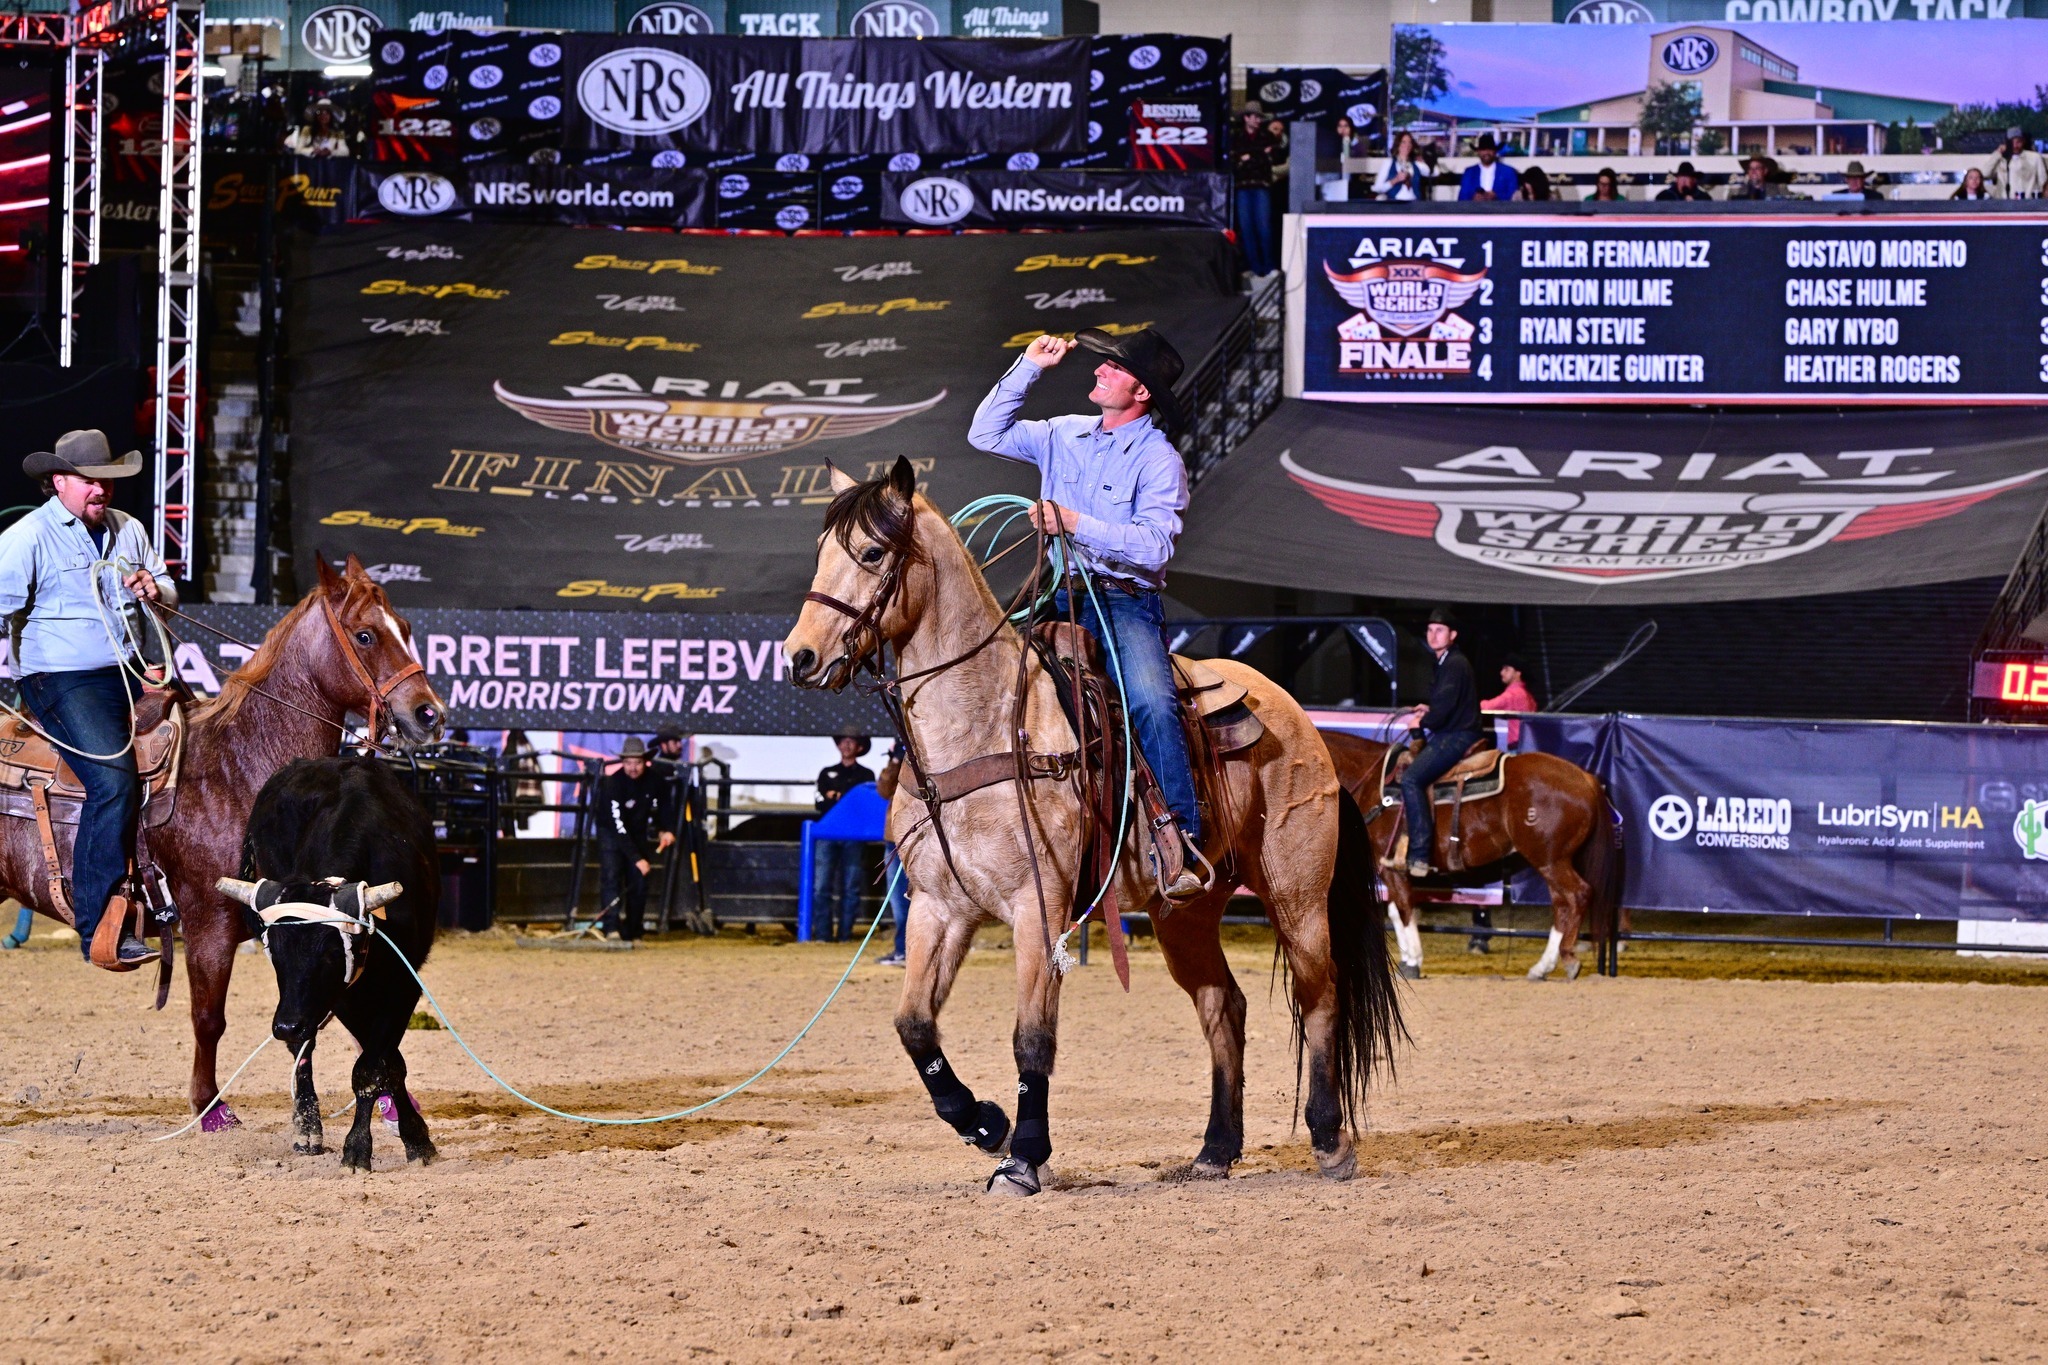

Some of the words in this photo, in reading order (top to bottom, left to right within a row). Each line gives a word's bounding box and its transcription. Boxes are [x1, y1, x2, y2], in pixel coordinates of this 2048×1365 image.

[409, 12, 436, 32] All
[739, 13, 821, 37] TACK
[963, 7, 990, 29] All
[991, 7, 1049, 29] Things
[314, 11, 372, 58] NRS
[1668, 38, 1709, 70] NRS
[601, 59, 687, 122] NRS
[731, 70, 789, 113] All
[795, 70, 917, 121] Things
[924, 70, 1073, 110] Western
[377, 118, 452, 137] 122
[1136, 126, 1208, 145] 122
[391, 177, 443, 210] NRS
[474, 182, 675, 208] NRSworld.com
[913, 184, 960, 218] NRS
[991, 188, 1185, 212] NRSworld.com
[100, 197, 161, 222] ester
[1354, 237, 1459, 257] ARIAT
[1481, 240, 1493, 268] 1
[1521, 240, 1589, 268] ELMER
[1592, 240, 1711, 268] FERNANDEZ
[1786, 239, 1877, 268] GUSTAVO
[1880, 239, 1967, 268] MORENO
[1393, 267, 1421, 278] XIX
[1369, 281, 1444, 297] WORLD
[1479, 278, 1494, 306] 2
[1519, 279, 1600, 306] DENTON
[1603, 279, 1674, 306] HULME
[1785, 278, 1852, 307] CHASE
[1856, 278, 1927, 306] HULME
[1373, 296, 1440, 312] SERIES
[1478, 316, 1493, 344] 3
[1519, 317, 1573, 345] RYAN
[1576, 317, 1647, 345] STEVIE
[1785, 318, 1839, 345] GARY
[1843, 318, 1899, 345] NYBO
[1339, 341, 1472, 369] FINALE
[1399, 372, 1445, 380] VEGAS
[1477, 353, 1493, 381] 4
[1519, 354, 1622, 382] MCKENZIE
[1624, 355, 1705, 382] GUNTER
[1784, 355, 1876, 382] HEATHER
[1880, 355, 1961, 383] ROGERS
[581, 372, 863, 399] ARIAT
[610, 412, 810, 431] WORLD
[617, 425, 797, 445] SERIES
[1434, 445, 1935, 481] ARIAT
[1471, 511, 1824, 533] WORLD
[1478, 530, 1797, 555] SERIES
[1478, 548, 1524, 562] OF
[1534, 552, 1622, 566] TEAM
[1642, 551, 1768, 566] ROPING
[449, 680, 686, 713] MORRISTOWN
[691, 684, 738, 714] AZ
[1696, 796, 1792, 835] LAREDO
[1818, 801, 1929, 832] LubriSyn
[1941, 806, 1985, 829] HA
[1695, 833, 1790, 850] CONVERSIONS
[1817, 835, 1870, 847] Hyaluronic
[1872, 836, 1895, 847] Acid
[1897, 838, 1923, 848] Joint
[1925, 839, 1985, 850] Supplement
